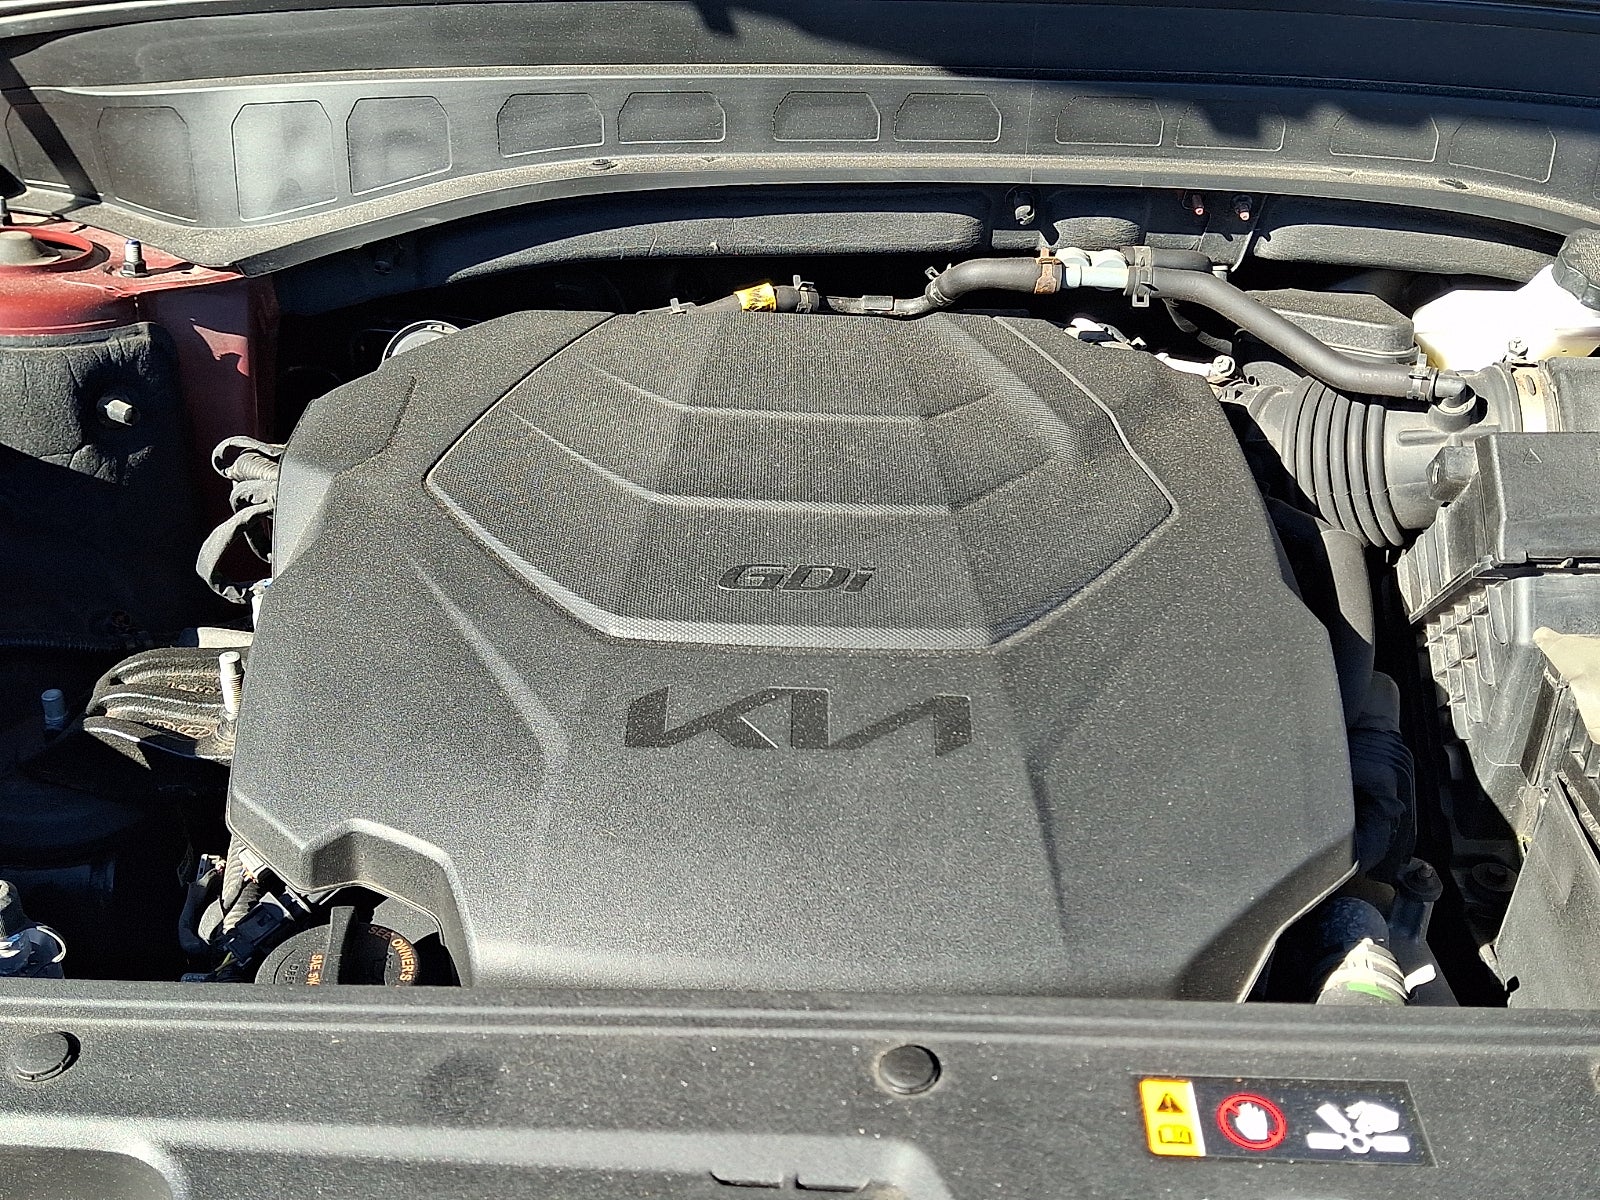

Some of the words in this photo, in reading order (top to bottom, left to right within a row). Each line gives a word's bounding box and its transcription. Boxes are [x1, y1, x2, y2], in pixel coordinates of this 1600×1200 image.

[718, 563, 876, 593] GDi
[625, 684, 972, 758] KIA
[310, 954, 323, 971] SAE
[368, 926, 391, 940] SEE
[391, 938, 415, 982] OWNER'S
